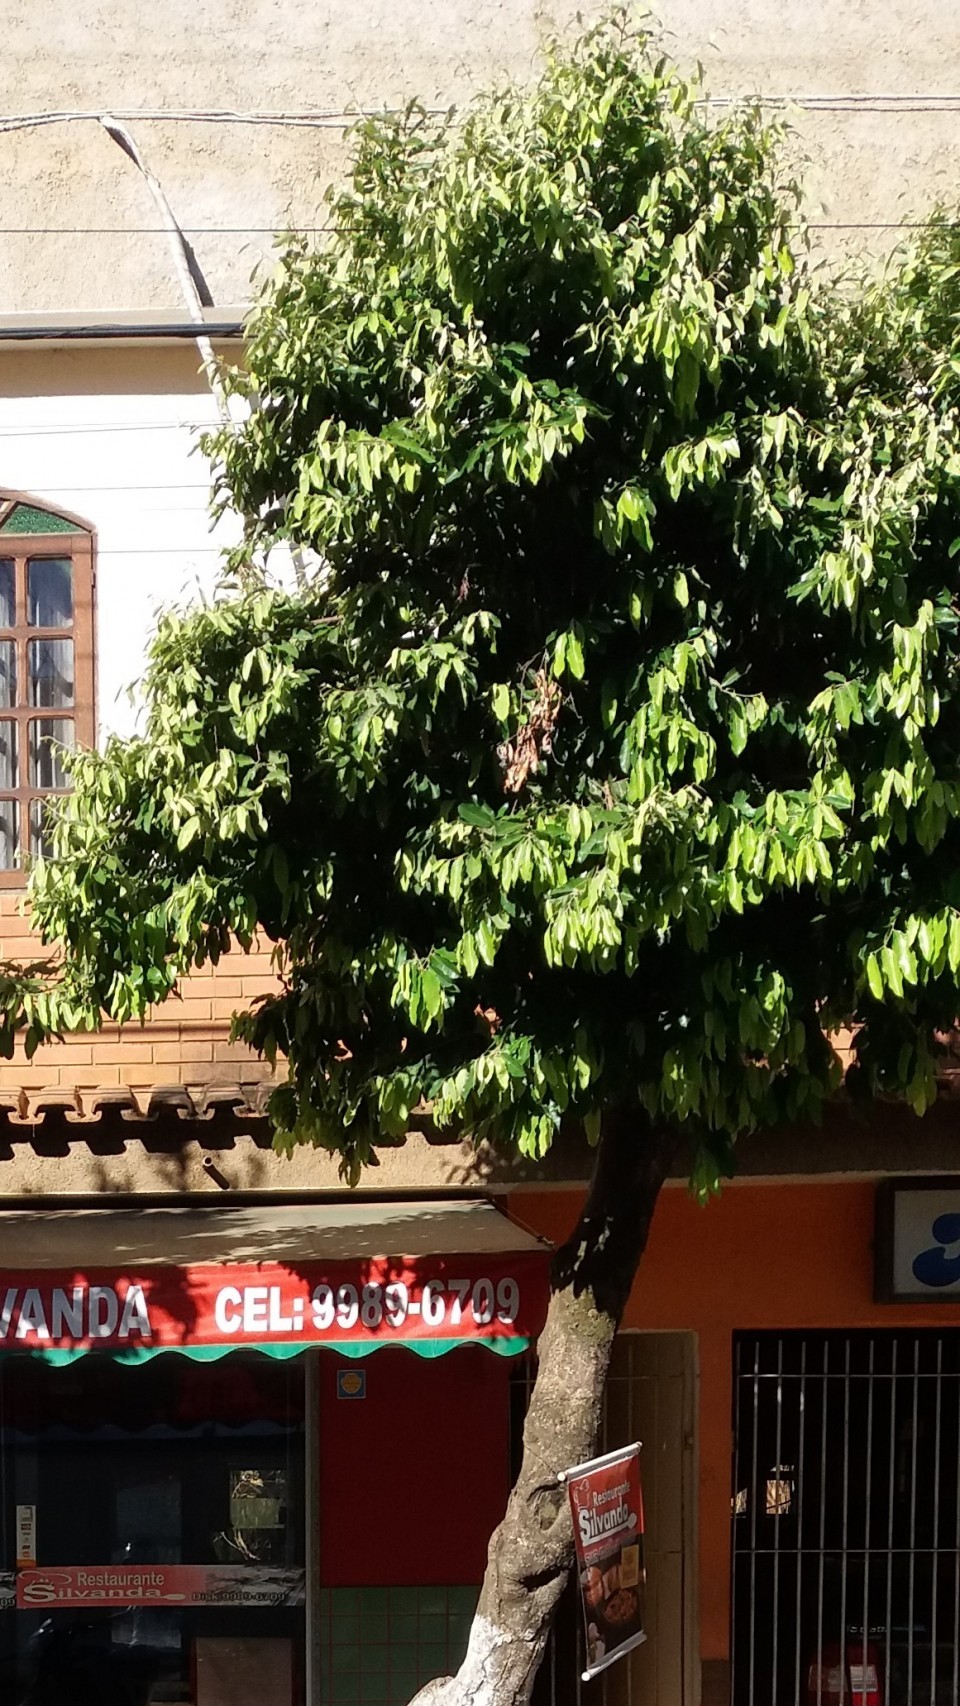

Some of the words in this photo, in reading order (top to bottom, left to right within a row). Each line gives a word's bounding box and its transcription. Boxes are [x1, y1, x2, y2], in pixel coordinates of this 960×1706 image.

[578, 1497, 630, 1541] Silvanda
[76, 1571, 165, 1588] Restaurante
[22, 1584, 162, 1603] Silvanda
